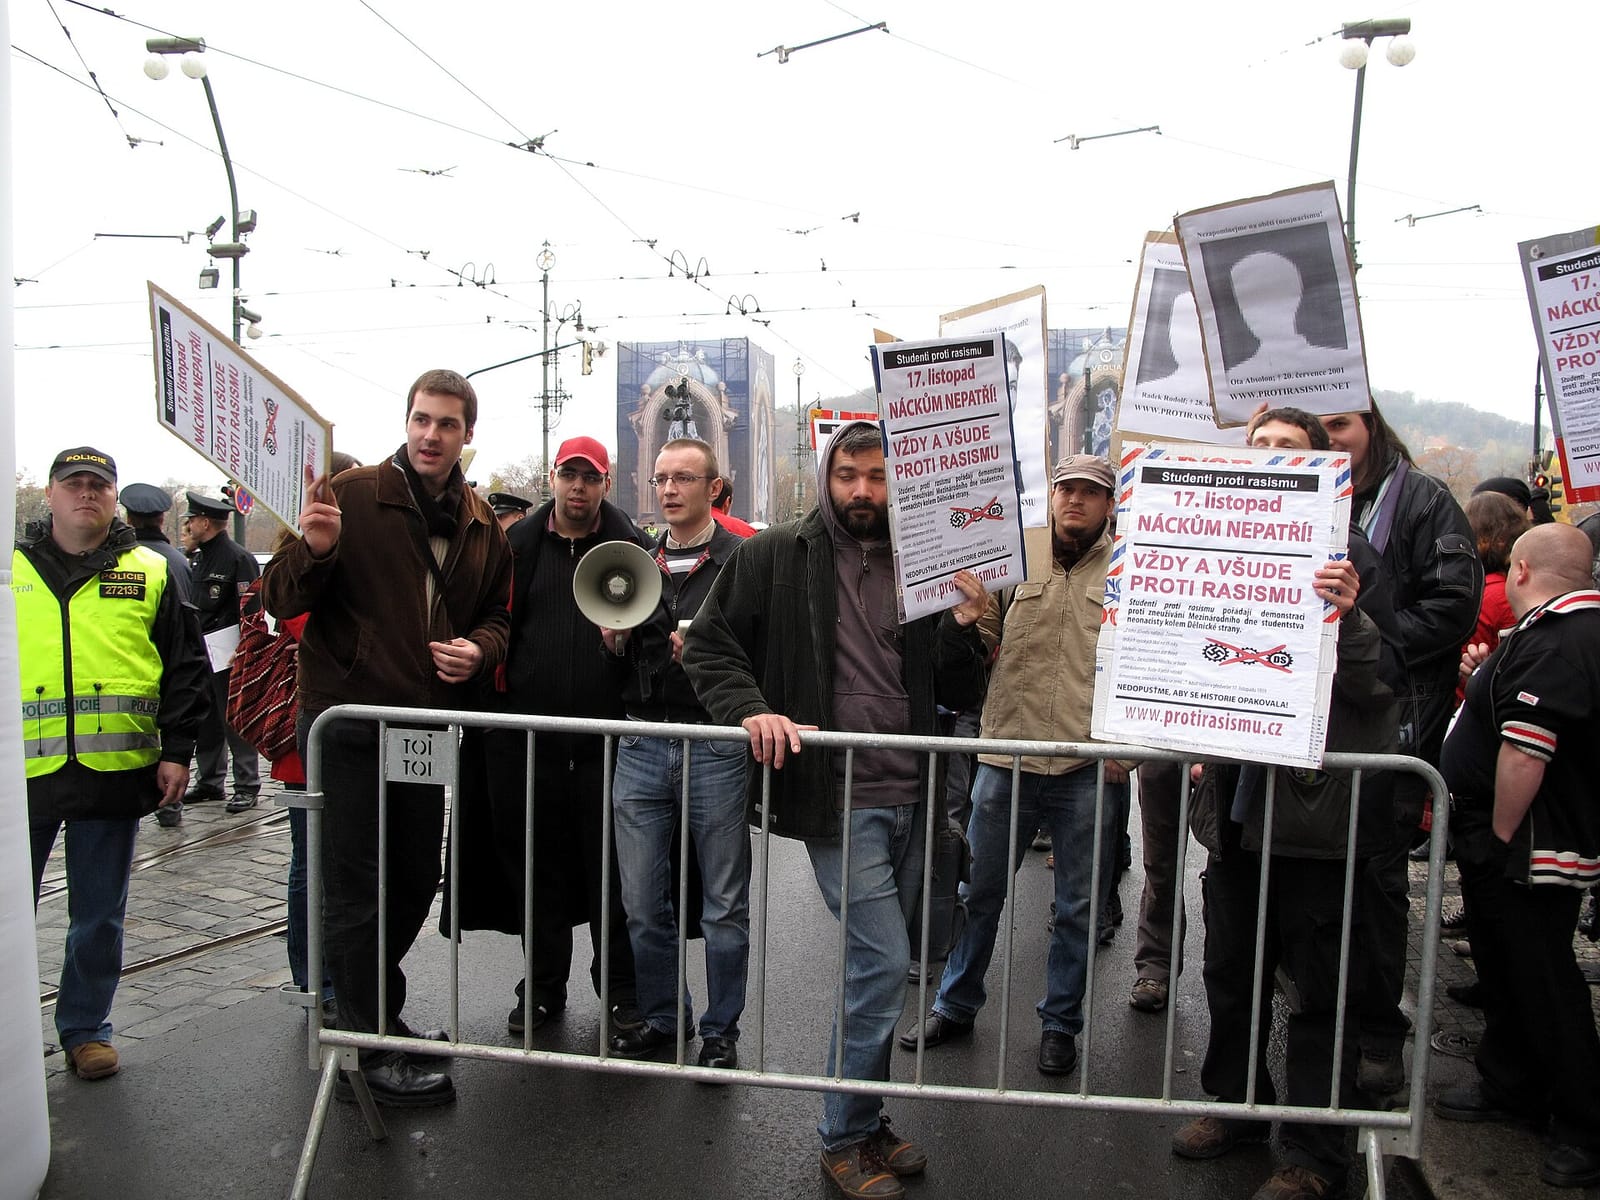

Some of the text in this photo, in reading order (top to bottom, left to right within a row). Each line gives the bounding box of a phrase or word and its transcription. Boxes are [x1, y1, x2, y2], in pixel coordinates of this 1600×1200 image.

[1571, 274, 1597, 292] 17.
[1552, 330, 1600, 352] VŽDY
[896, 346, 981, 364] Studenti proti rasismu
[174, 338, 189, 412] 17. listopad
[906, 362, 975, 388] 17. listopad
[1327, 366, 1344, 374] 2001
[888, 383, 997, 419] NÁCKŮM NEPATŘÍ!
[1230, 382, 1350, 400] WWW.PROTIRASISMU.NET
[213, 359, 226, 463] VŽDY A VŠUDE
[228, 363, 240, 476] PROTI RASISMU
[892, 424, 990, 457] VŽDY A VŠUDE
[66, 454, 108, 464] POLICIE
[894, 444, 998, 480] PROTI RASISMU
[1161, 471, 1297, 488] Studenti proti rasismu
[1173, 490, 1282, 515] 17. listopad
[1137, 512, 1312, 542] NÁCKŮM NEPATŘÍ!
[1133, 549, 1292, 580] VŽDY A VŠUDE
[100, 572, 145, 582] POLICIE
[104, 585, 140, 596] 272135
[1129, 574, 1194, 596] PROTI
[1201, 580, 1302, 604] RASISMU
[1128, 597, 1157, 607] Studenti
[1163, 602, 1181, 610] proti
[1187, 604, 1215, 612] rasismu
[1126, 616, 1163, 627] neonacisty
[1164, 618, 1185, 627] kolem
[1186, 620, 1216, 630] Dělnické
[1218, 624, 1241, 634] strany.
[1127, 607, 1144, 615] proti
[1243, 616, 1257, 625] dne
[1261, 619, 1304, 629] studentstva
[1273, 655, 1286, 664] DS
[1116, 683, 1171, 696] NEDOPUSŤME,
[1172, 689, 1188, 697] ABY
[1200, 692, 1236, 702] HISTORIE
[1237, 696, 1288, 708] OPAKOVALA!
[1125, 705, 1282, 736] www.protirasismu.cz
[402, 738, 432, 756] TOI
[402, 760, 432, 777] TOI
